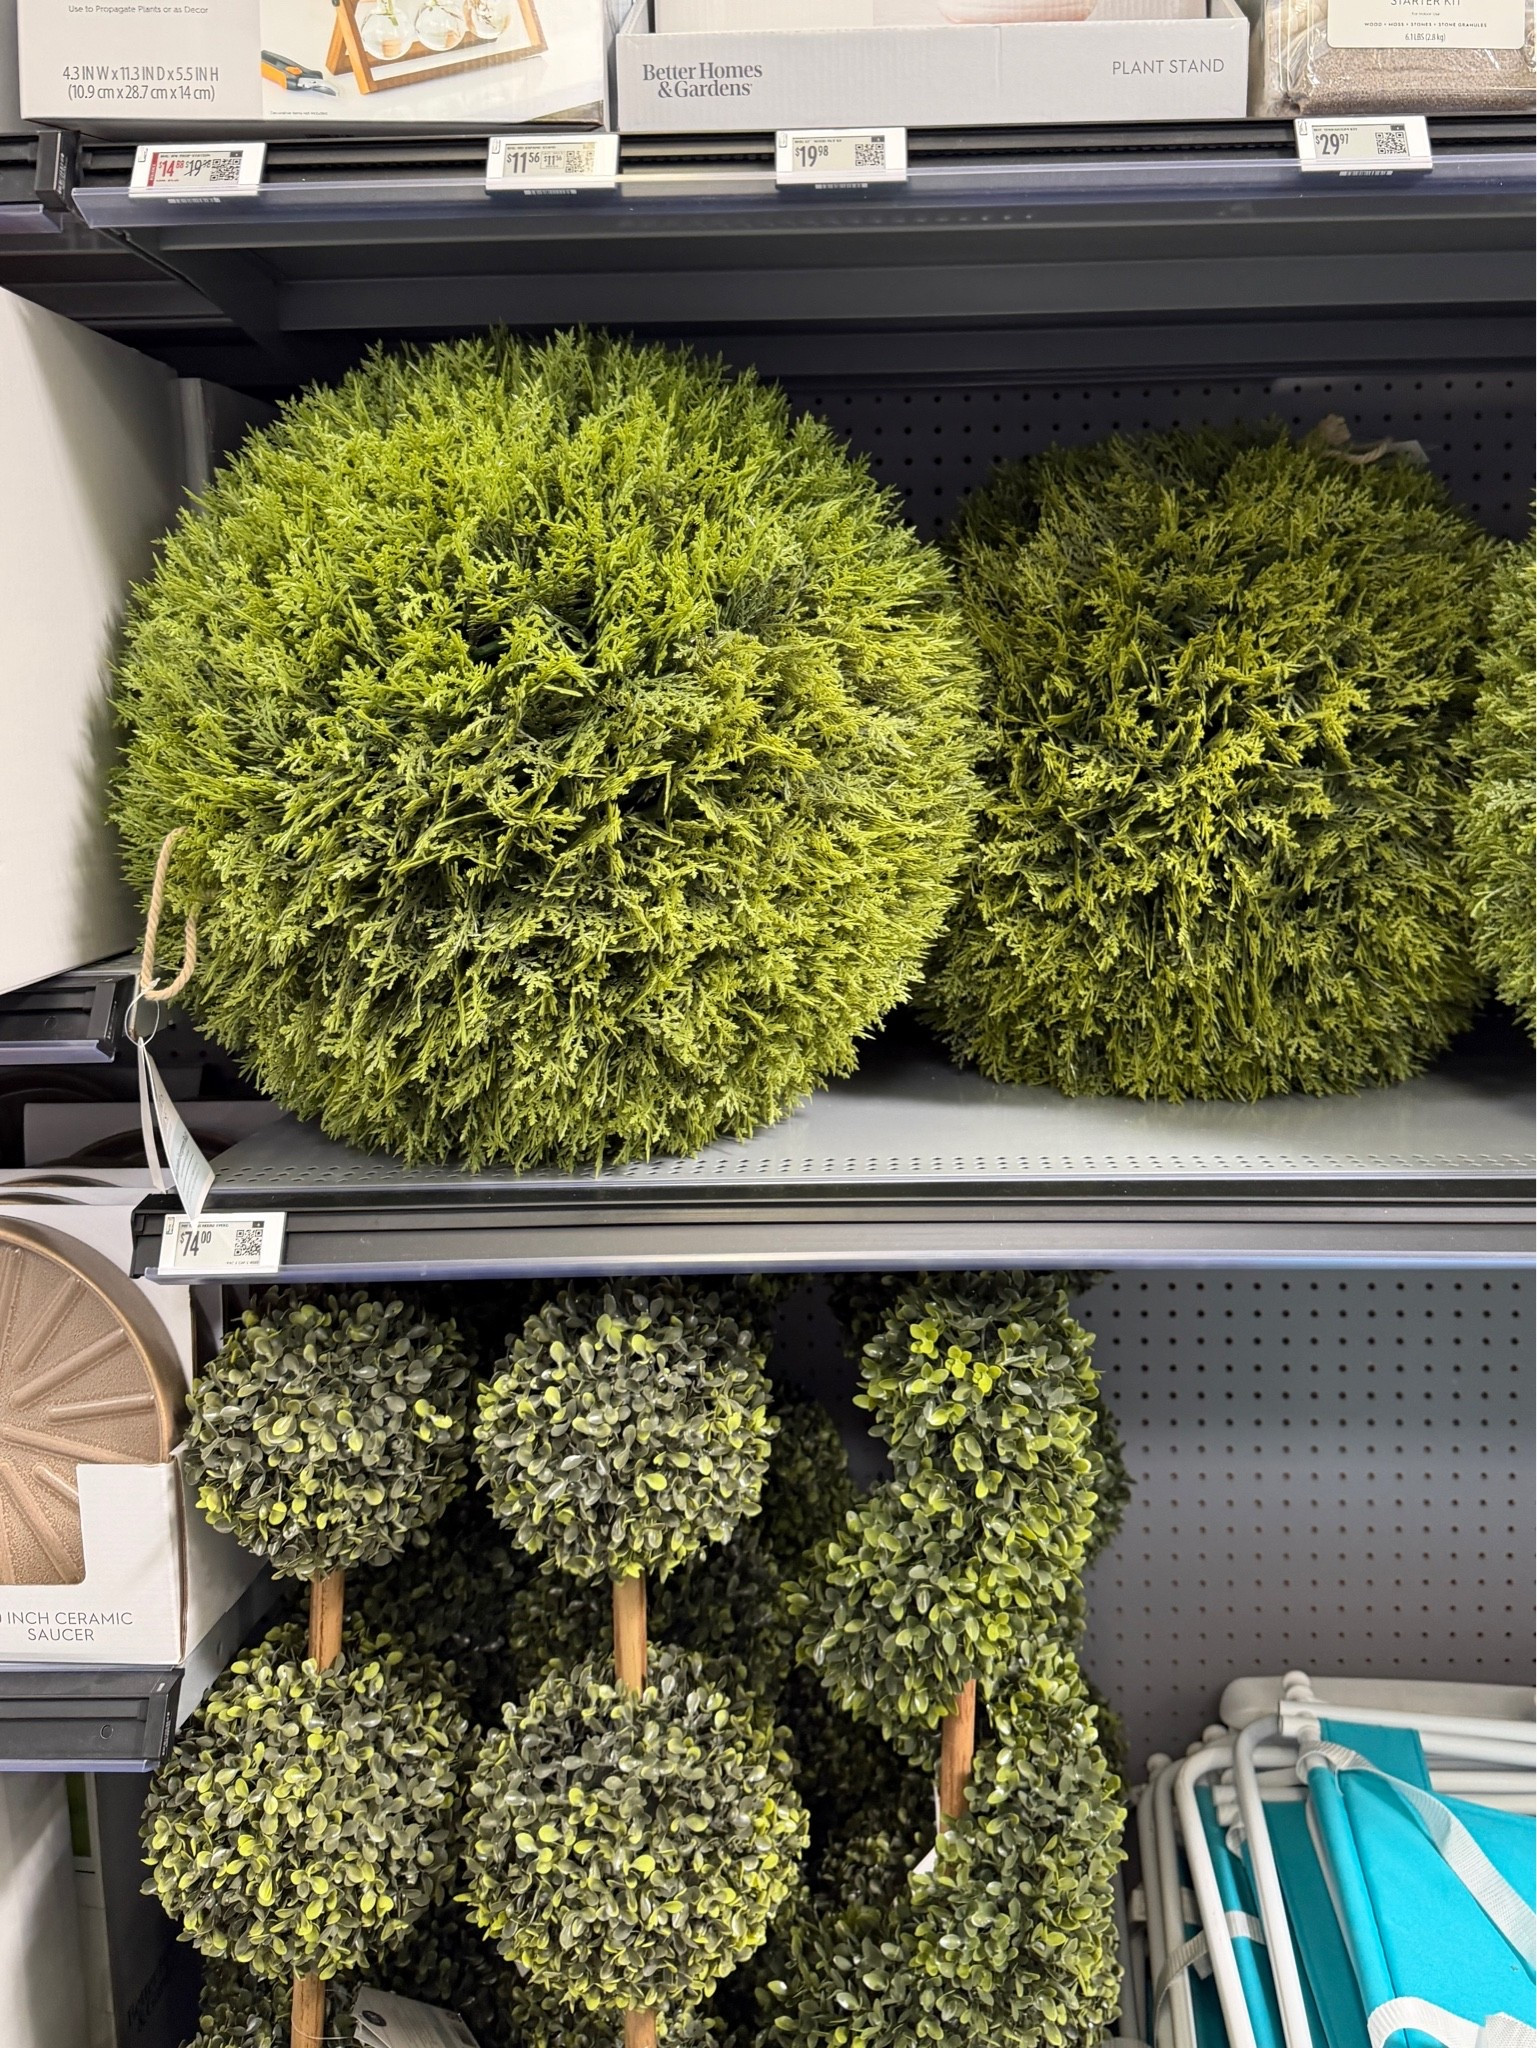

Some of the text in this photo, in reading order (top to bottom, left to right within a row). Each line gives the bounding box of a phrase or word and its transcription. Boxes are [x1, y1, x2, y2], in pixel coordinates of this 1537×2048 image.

[68, 5, 84, 13] Use
[85, 5, 94, 13] to
[96, 5, 136, 14] Propagate
[138, 5, 161, 13] Plants
[184, 6, 209, 14] Decor
[63, 66, 219, 82] 4.3 IN W x 11.3 IN D x 5.5 IN H
[642, 62, 763, 81] Better Homes
[1113, 58, 1225, 75] PLANT STAND
[68, 84, 215, 102] (10.9 cm x 28.7 cm x 14 cm)
[658, 80, 751, 98] & Gardens
[7, 1611, 49, 1625] INCH
[55, 1611, 133, 1625] CERAMIC
[28, 1628, 95, 1641] SAUCER
